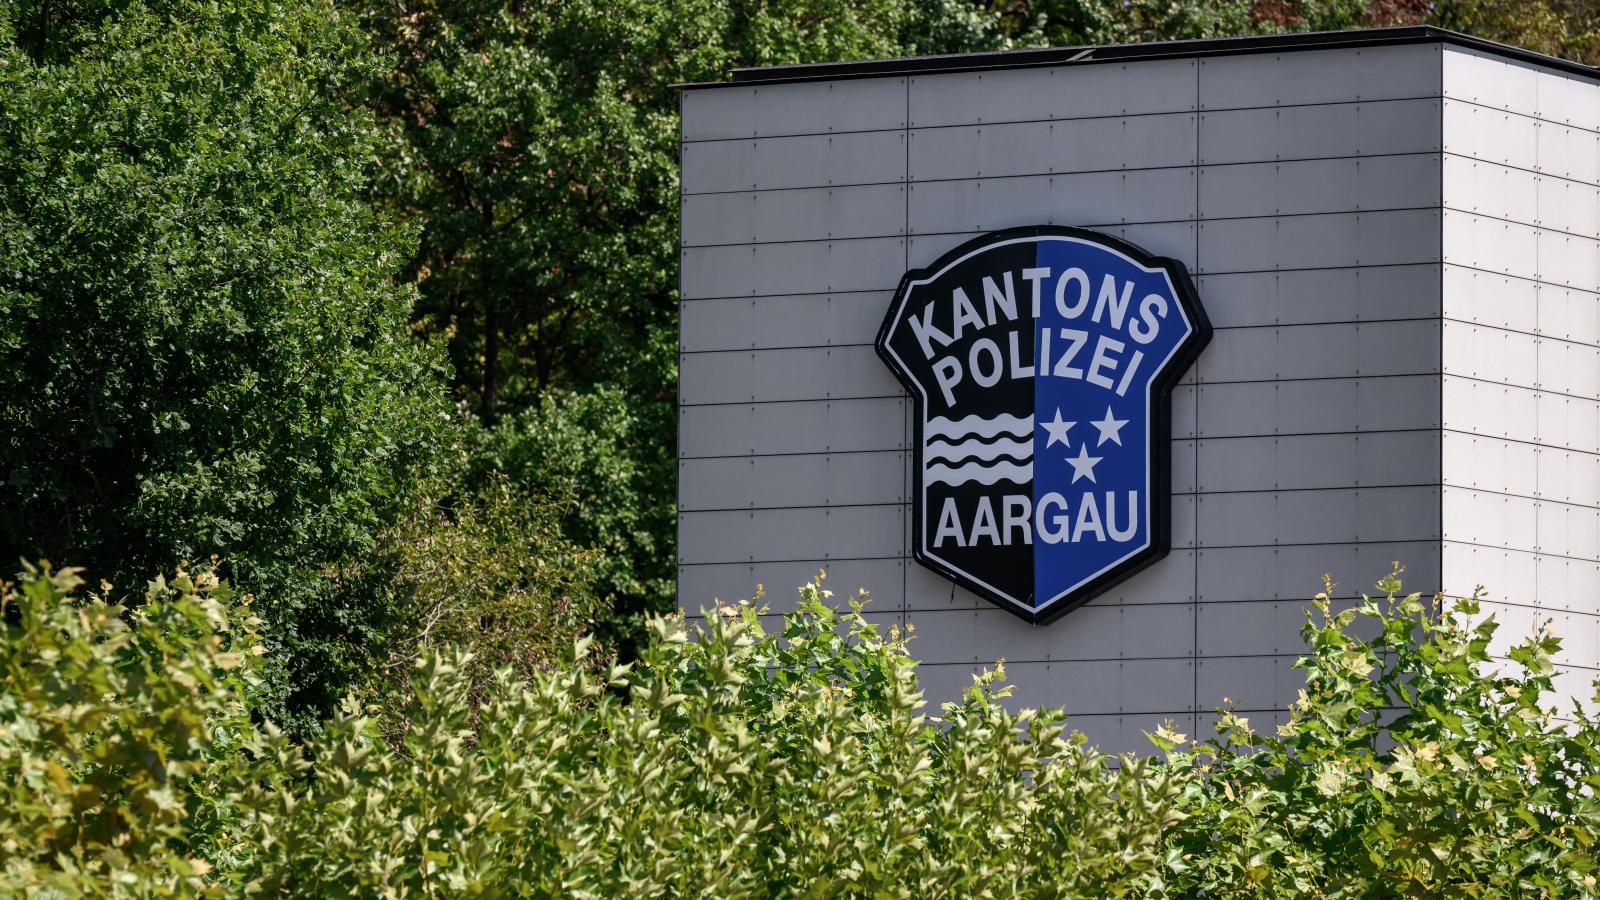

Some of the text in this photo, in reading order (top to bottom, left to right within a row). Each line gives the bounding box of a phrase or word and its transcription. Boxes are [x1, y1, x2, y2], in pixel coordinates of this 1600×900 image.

[907, 267, 1168, 360] KANTONS
[931, 327, 1144, 407] POLIZEI
[933, 490, 1138, 548] AARGAU
